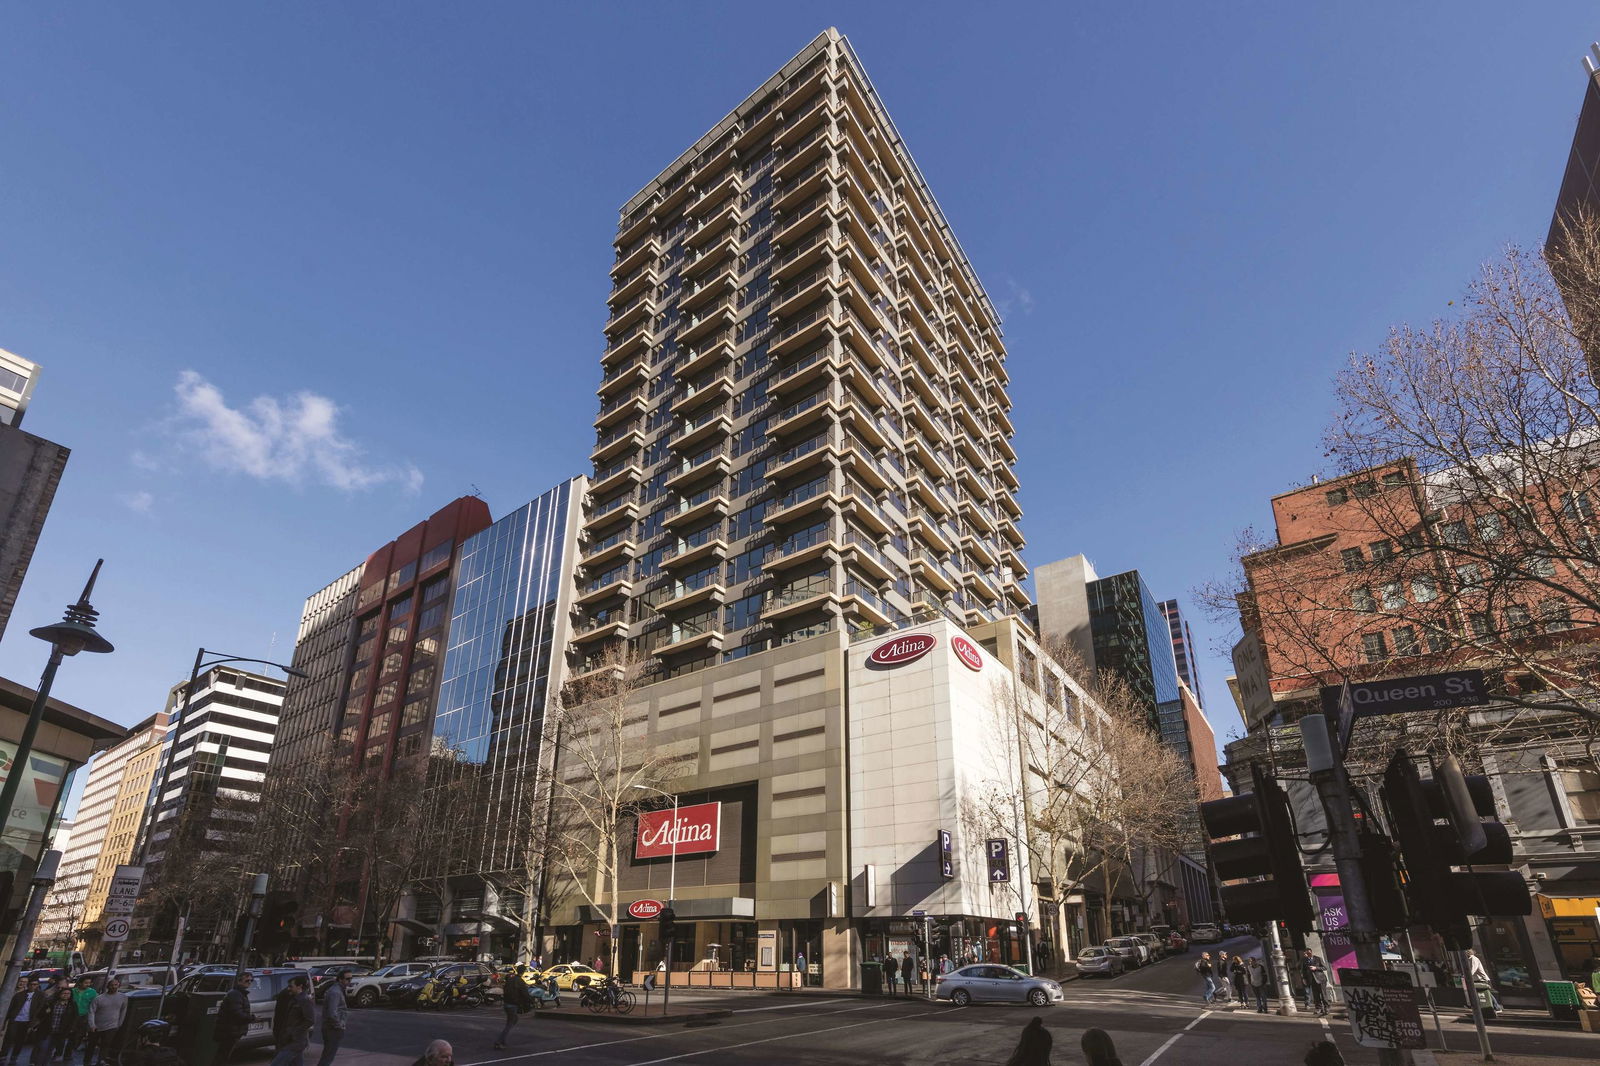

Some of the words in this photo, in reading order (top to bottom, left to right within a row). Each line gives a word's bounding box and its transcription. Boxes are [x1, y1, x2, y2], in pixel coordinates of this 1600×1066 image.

[879, 640, 925, 659] Adina
[958, 641, 980, 665] Adina
[1237, 643, 1256, 672] ONE
[1242, 666, 1263, 699] WAY
[1353, 683, 1437, 704] Queen
[1444, 677, 1475, 694] St
[1433, 698, 1452, 707] 200
[1460, 695, 1480, 705] 236
[641, 817, 712, 846] Adina
[943, 833, 950, 850] P
[991, 842, 1003, 857] P
[114, 887, 136, 895] LANE
[633, 902, 657, 913] Adina
[1323, 908, 1343, 917] ASK
[1325, 917, 1339, 926] US
[108, 924, 127, 934] 40
[1329, 937, 1351, 946] NBN
[1395, 1020, 1418, 1028] Fine
[1396, 1028, 1421, 1037] $100
